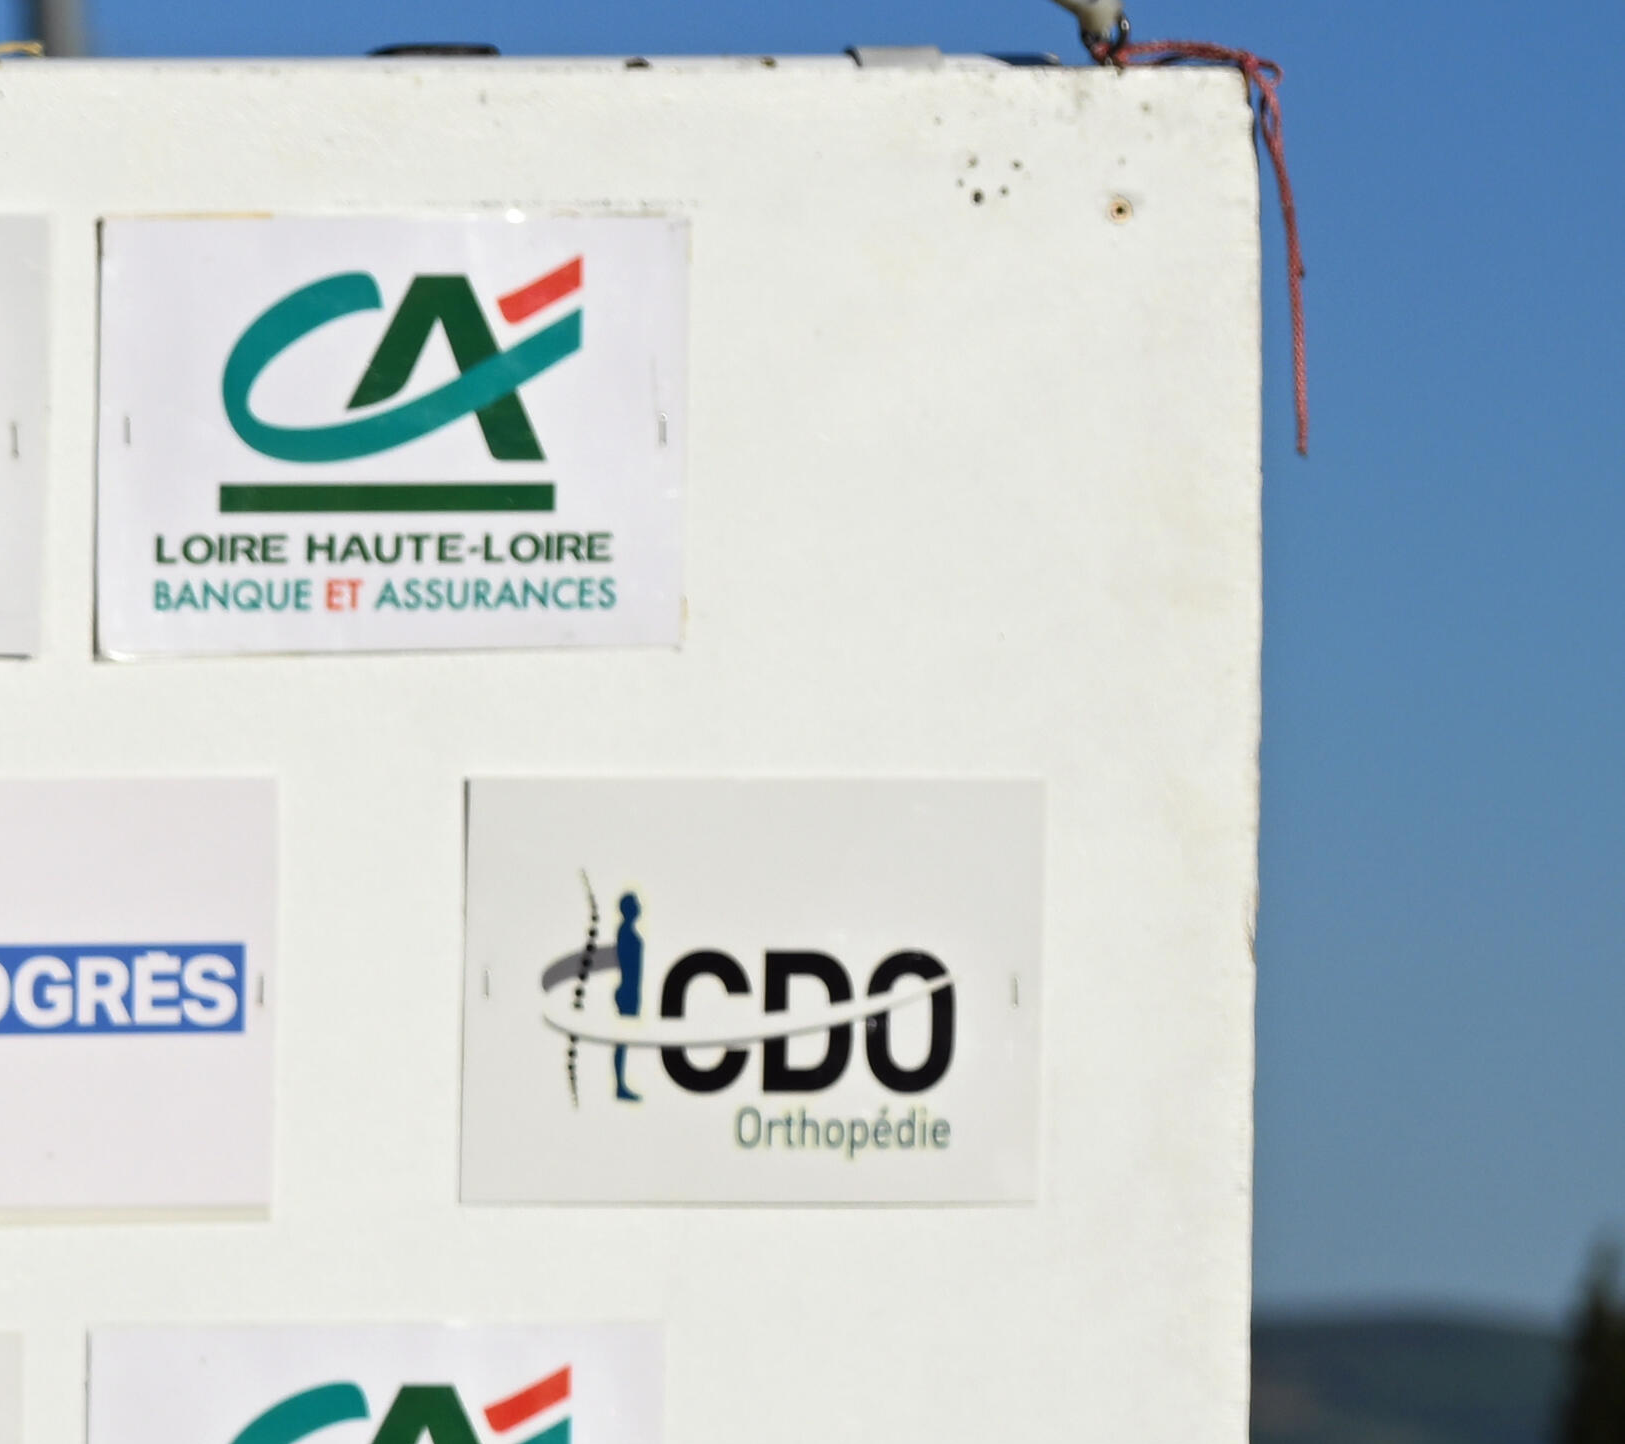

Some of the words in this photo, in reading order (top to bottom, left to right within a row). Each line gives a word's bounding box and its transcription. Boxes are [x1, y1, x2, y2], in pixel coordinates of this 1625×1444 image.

[155, 534, 289, 566] LOIRE
[307, 531, 613, 566] HAUTE-LOIRE
[153, 579, 313, 614] BANQUE
[325, 579, 364, 612] ET
[375, 575, 618, 611] ASSURANCES
[660, 948, 957, 1094] CDO
[734, 1105, 952, 1160] Orthopédie
